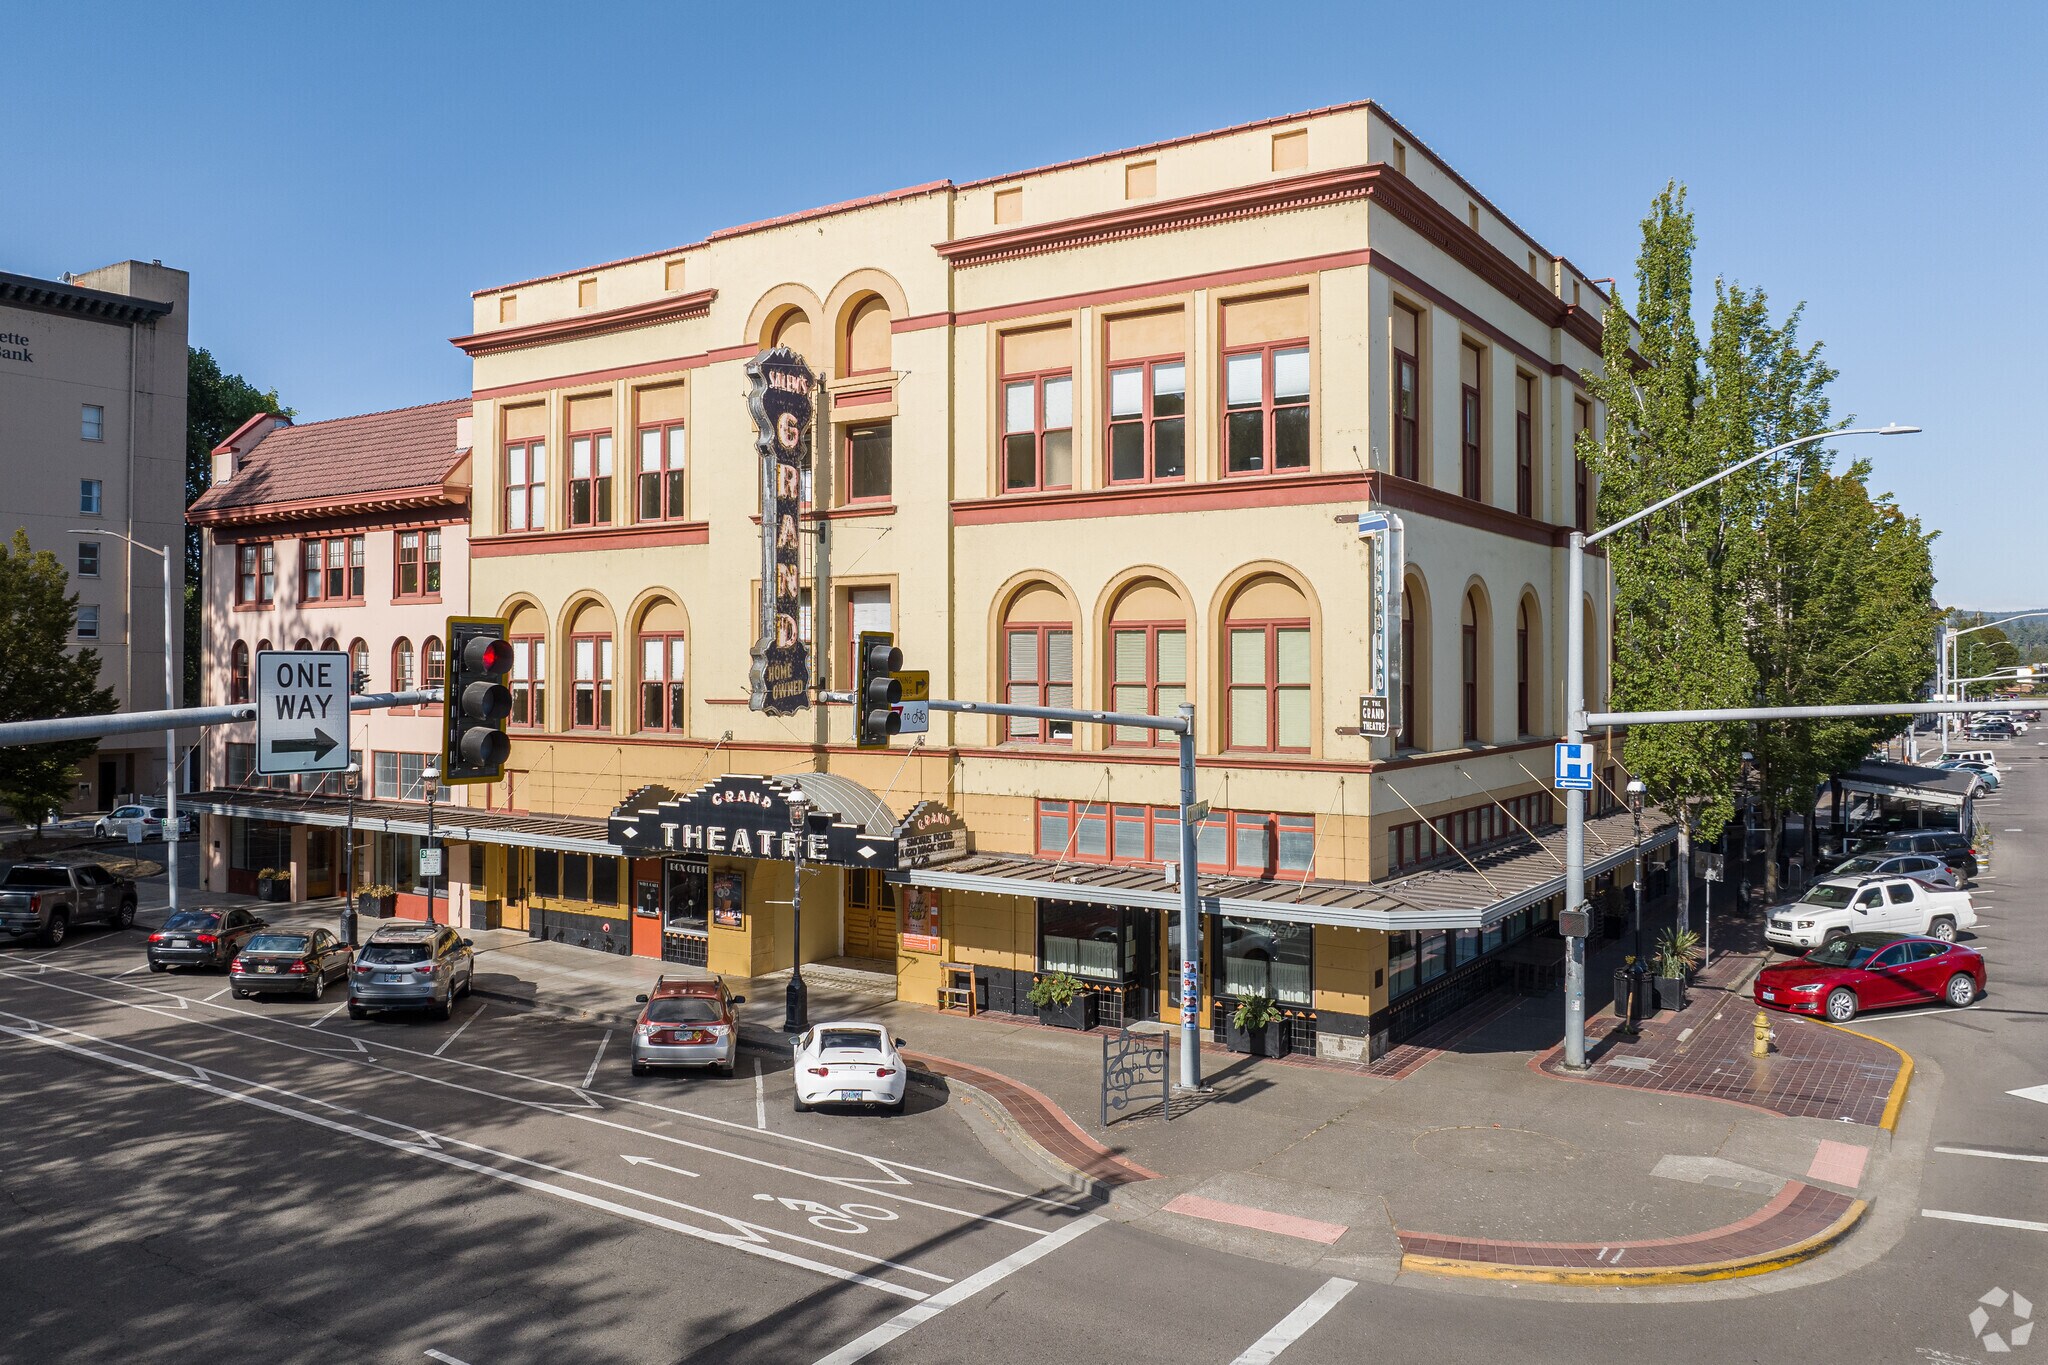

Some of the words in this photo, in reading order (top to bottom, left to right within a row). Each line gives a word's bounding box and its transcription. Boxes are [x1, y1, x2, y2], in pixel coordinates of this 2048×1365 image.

[0, 347, 34, 363] ank
[777, 412, 800, 649] GRAND
[277, 663, 332, 688] ONE
[768, 662, 793, 682] HOME
[772, 680, 803, 700] OWNED
[276, 695, 333, 720] WAY
[1362, 708, 1385, 719] GRAND
[904, 713, 910, 721] TO
[1363, 721, 1386, 731] THEATRE
[712, 790, 772, 808] GRAND
[917, 812, 951, 830] GRAND
[660, 822, 829, 860] THEATRE
[900, 849, 905, 858] A
[670, 863, 686, 872] BOX
[687, 865, 708, 875] OFFIC
